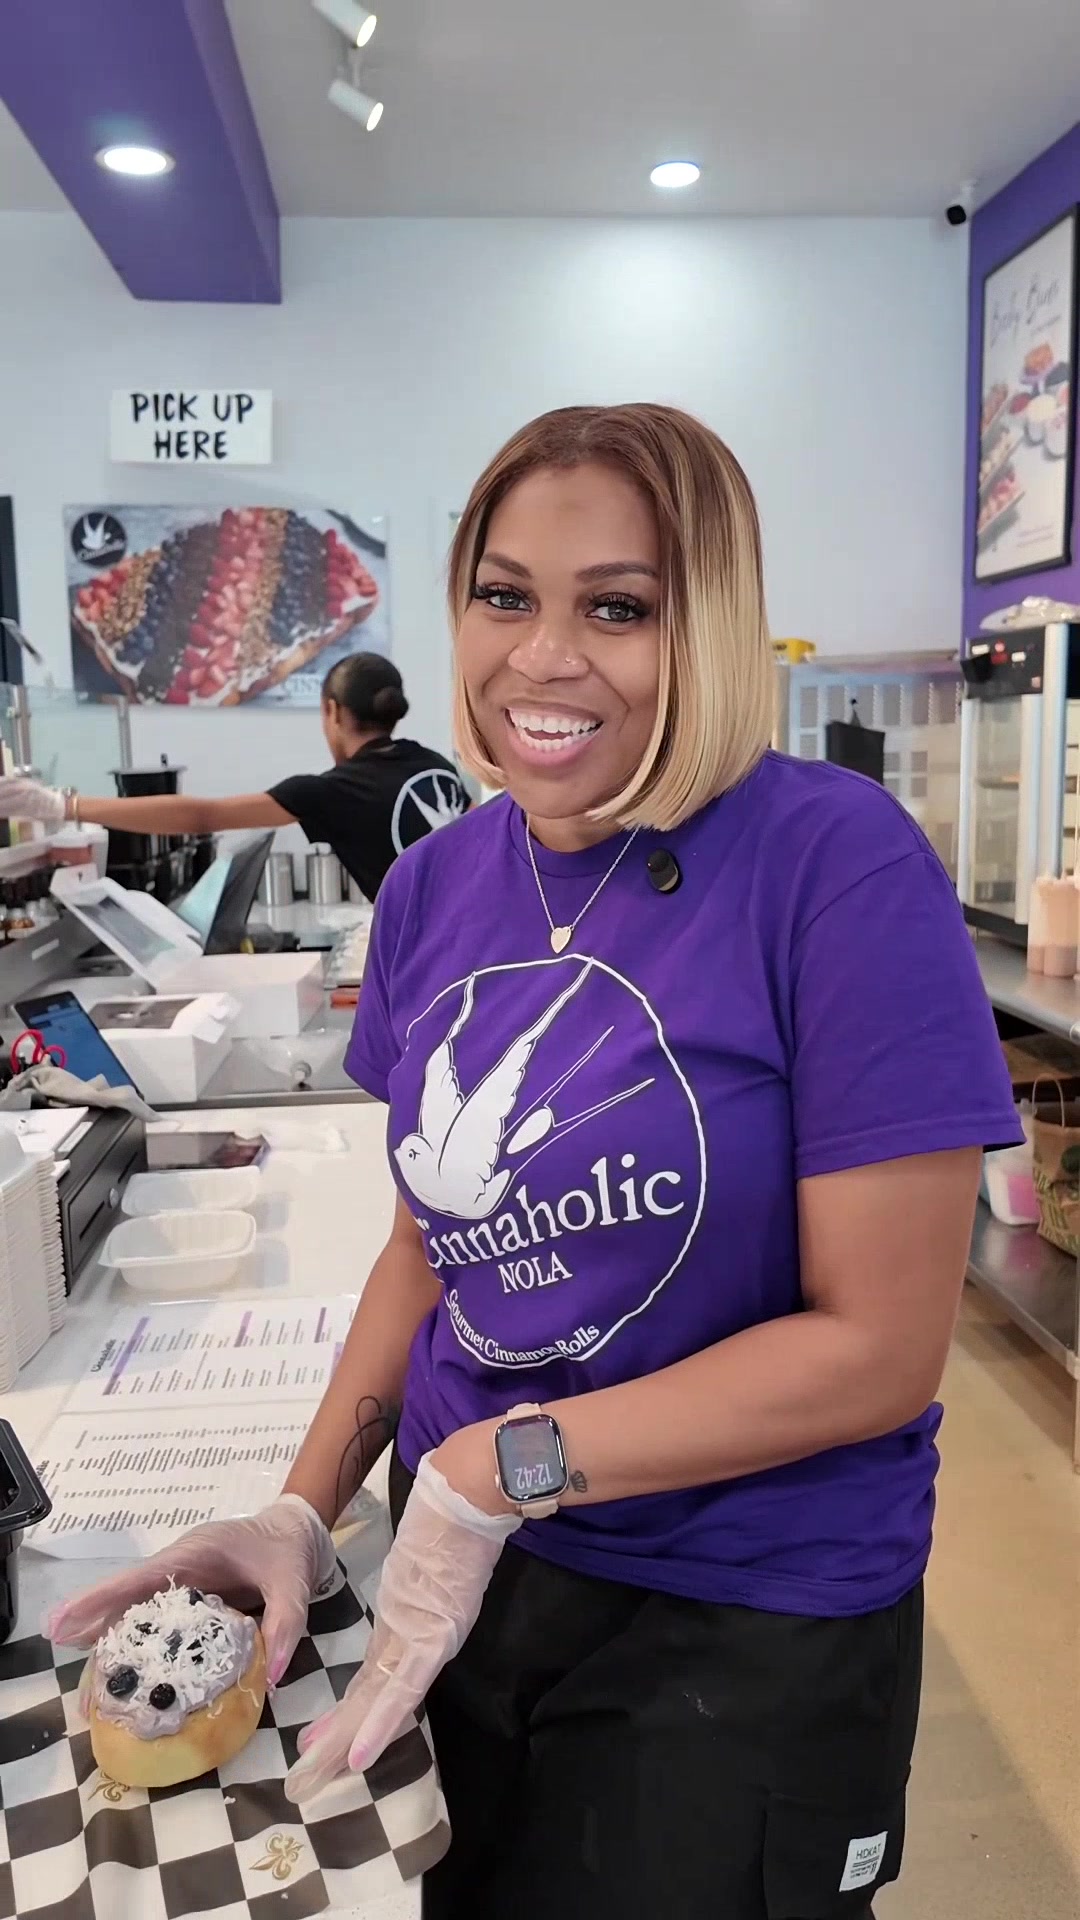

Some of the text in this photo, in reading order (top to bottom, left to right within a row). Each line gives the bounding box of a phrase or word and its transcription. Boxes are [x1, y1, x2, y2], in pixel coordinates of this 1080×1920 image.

[131, 392, 254, 423] PICK UP
[154, 431, 229, 460] HERE
[413, 1153, 685, 1270] innaholic
[499, 1251, 573, 1294] NOLA
[449, 1289, 600, 1362] Gourmet Cinnamon Rolls
[514, 1463, 554, 1490] 12:42
